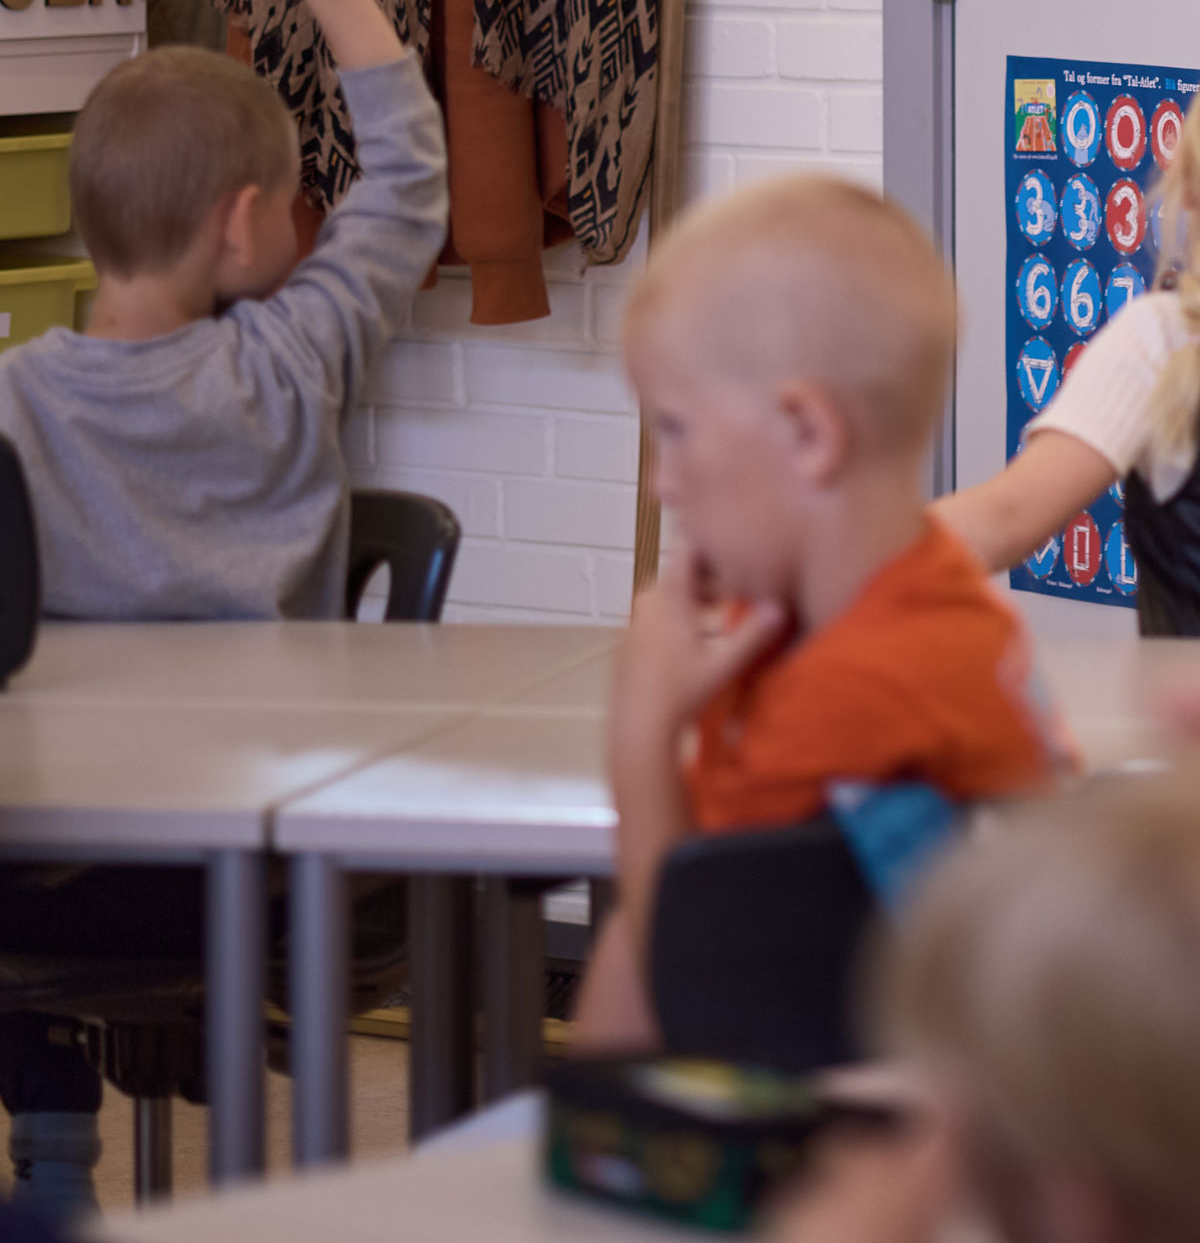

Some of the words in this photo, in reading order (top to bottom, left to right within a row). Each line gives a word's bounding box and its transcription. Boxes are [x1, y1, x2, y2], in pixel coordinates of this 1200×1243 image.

[1063, 70, 1075, 82] Tal
[1077, 74, 1085, 85] og
[1087, 72, 1110, 85] former
[1111, 74, 1122, 85] fra
[1025, 177, 1043, 235] 3
[1070, 180, 1087, 240] 3
[1113, 186, 1138, 247] 3
[1026, 264, 1050, 319] 6
[1071, 265, 1093, 327] 6
